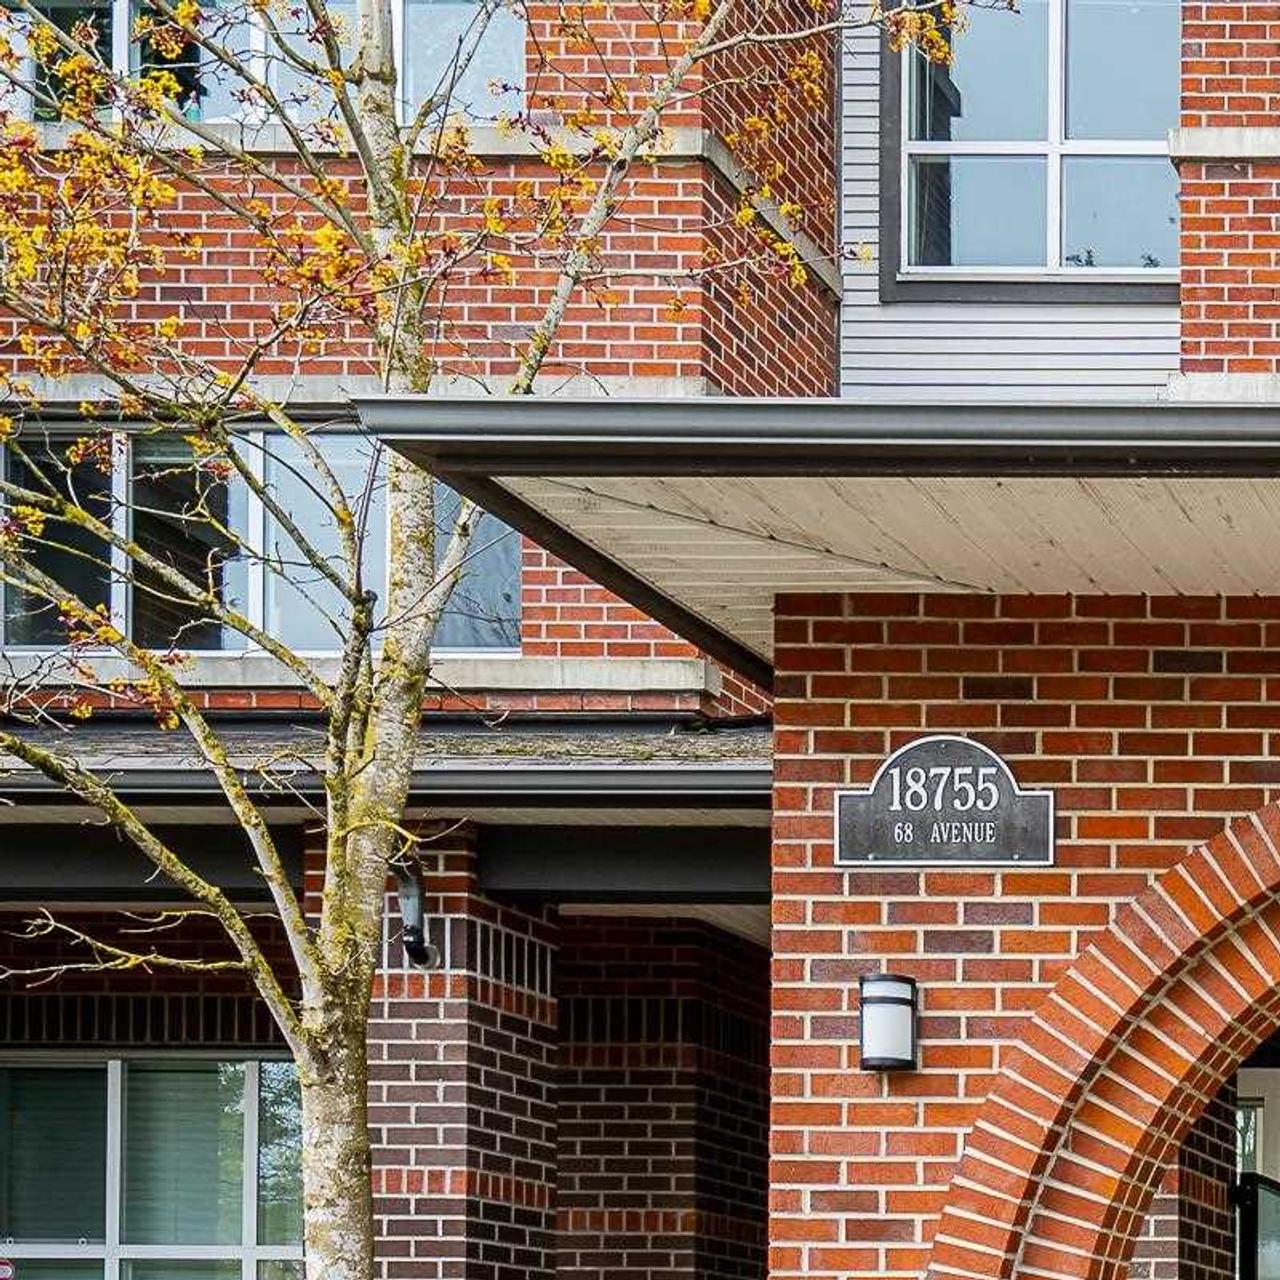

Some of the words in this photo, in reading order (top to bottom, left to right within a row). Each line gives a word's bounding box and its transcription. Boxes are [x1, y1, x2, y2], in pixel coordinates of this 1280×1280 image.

[888, 766, 1000, 811] 18755
[894, 822, 914, 843] 68
[930, 822, 997, 843] AVENUE
